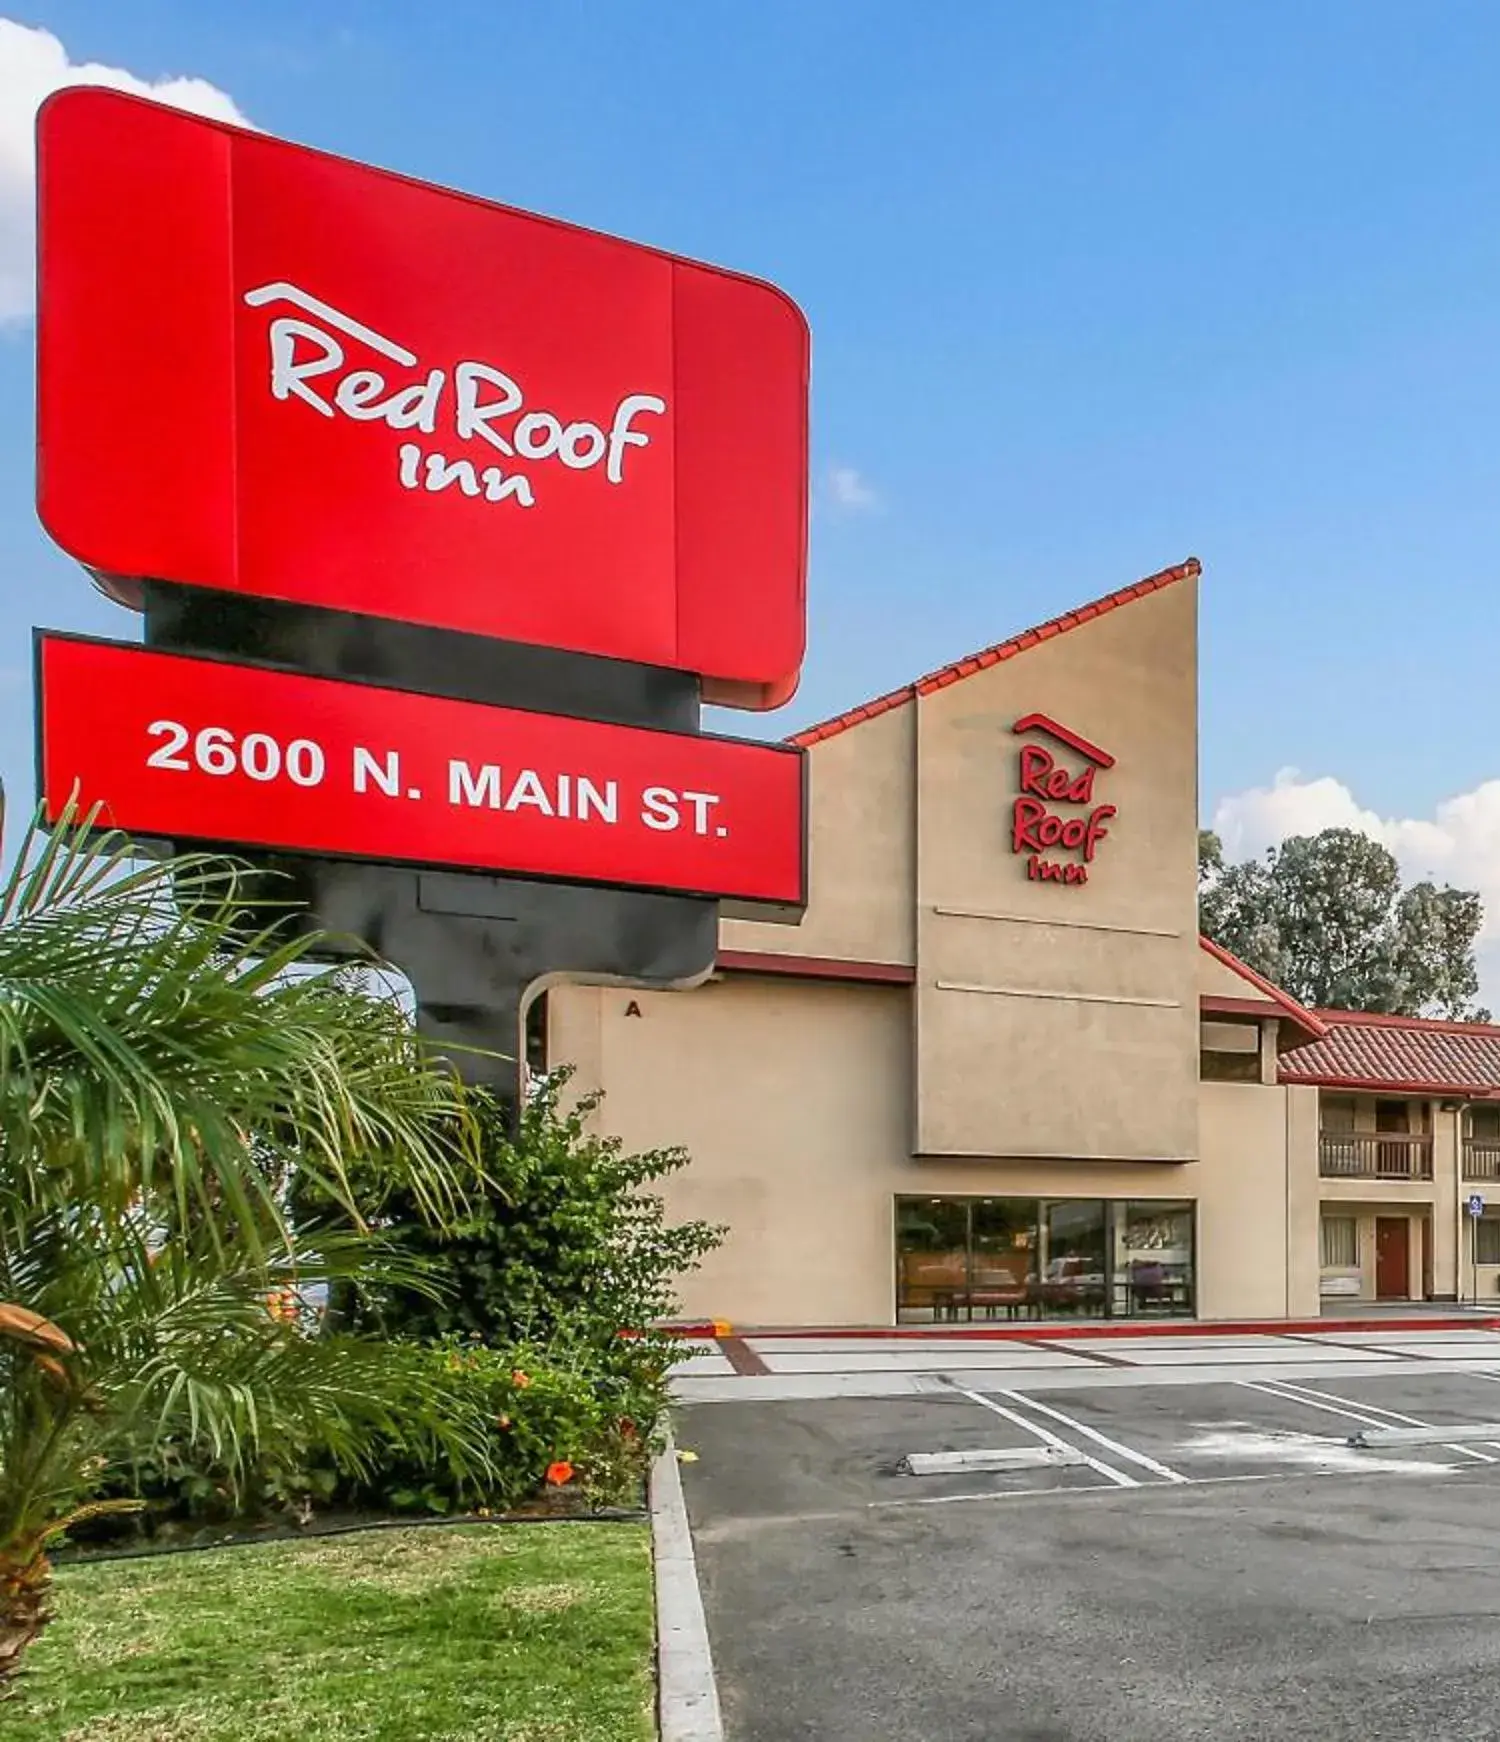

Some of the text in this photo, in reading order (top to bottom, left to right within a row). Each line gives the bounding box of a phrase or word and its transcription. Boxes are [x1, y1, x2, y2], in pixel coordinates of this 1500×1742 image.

[268, 318, 666, 484] Red Roof
[147, 720, 728, 837] 2600 N. MAIN ST.
[1020, 744, 1097, 804] Red
[1012, 796, 1117, 863] Roof
[624, 1000, 642, 1018] A
